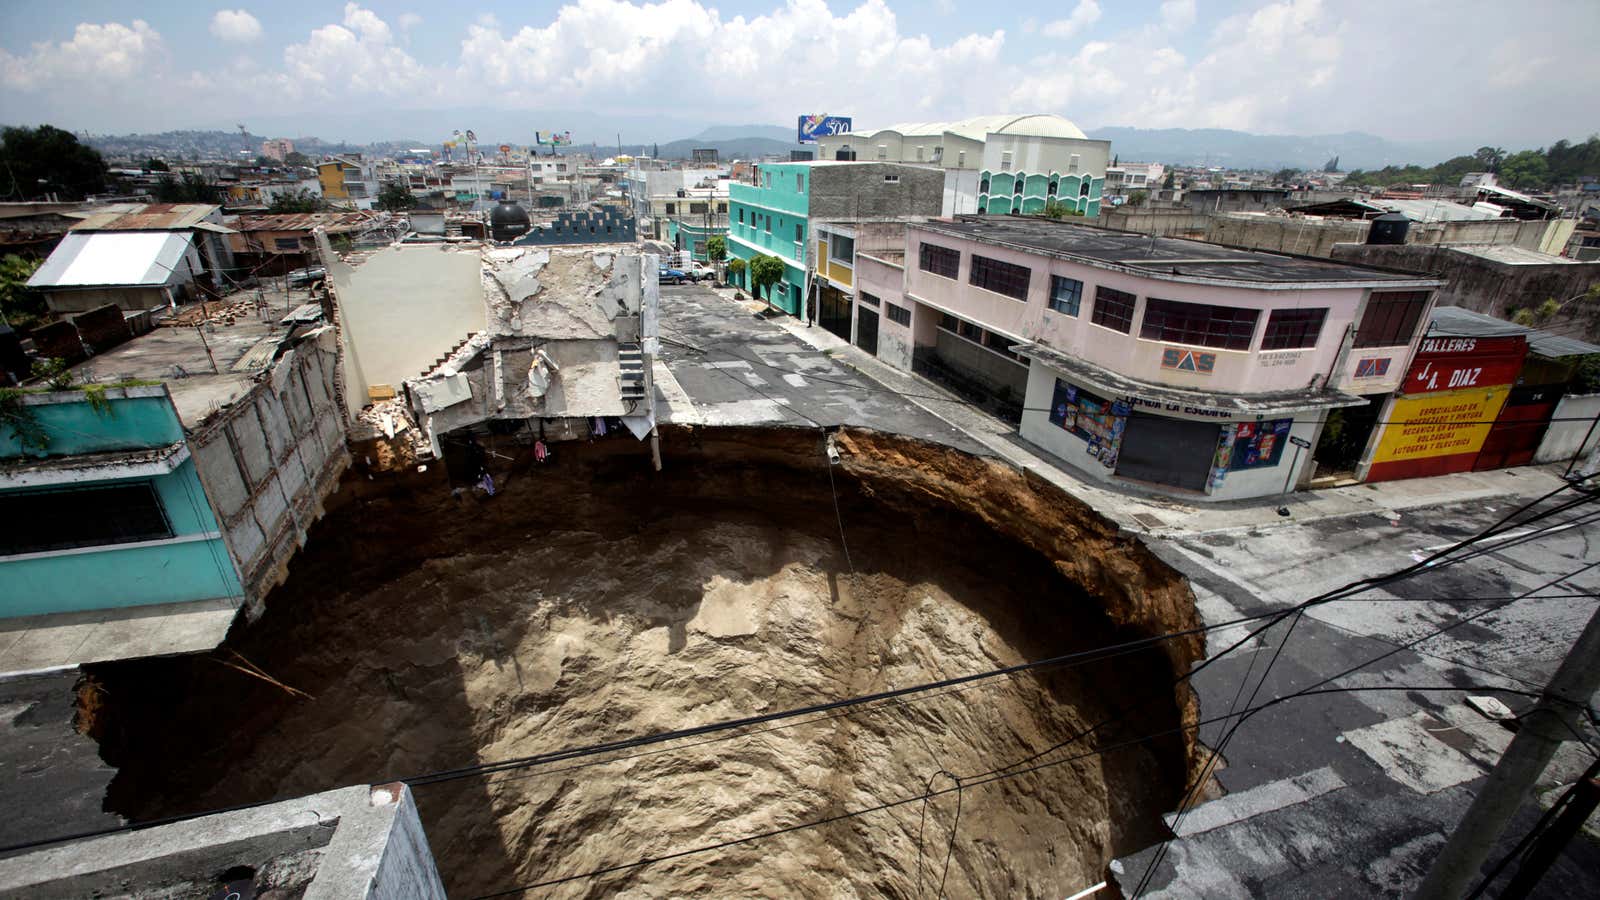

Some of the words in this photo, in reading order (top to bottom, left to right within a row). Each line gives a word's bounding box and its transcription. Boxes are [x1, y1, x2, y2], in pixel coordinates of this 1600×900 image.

[827, 122, 849, 136] 500
[1420, 339, 1476, 352] TALLERES
[1161, 349, 1216, 372] SAS
[1417, 362, 1432, 380] J.
[1426, 371, 1439, 390] A.
[1447, 367, 1482, 388] DIAZ
[1165, 402, 1180, 412] LA
[1420, 405, 1468, 416] ESPECIALIDAD
[1456, 412, 1483, 420] PINTURA
[1393, 444, 1427, 455] AUTOGENA
[1435, 439, 1470, 448] ELECTRICA
